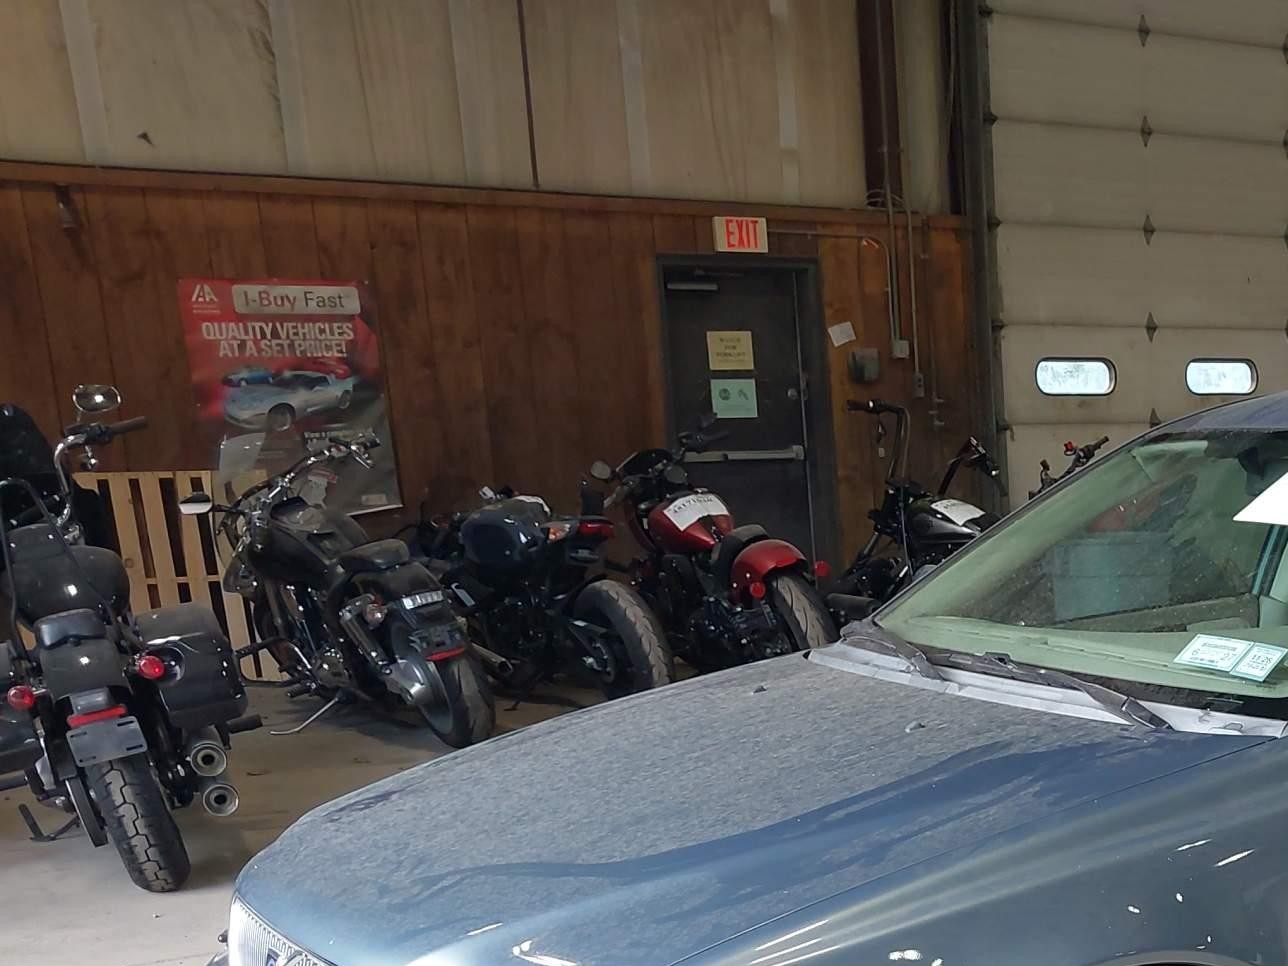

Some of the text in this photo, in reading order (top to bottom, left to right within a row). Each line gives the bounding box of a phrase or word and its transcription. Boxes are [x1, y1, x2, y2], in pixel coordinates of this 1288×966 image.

[725, 218, 759, 248] EXIT
[243, 290, 345, 312] I-Buy Fast
[201, 321, 354, 340] QUALITY VEHICLES
[218, 340, 348, 358] AT A SET PRICE!
